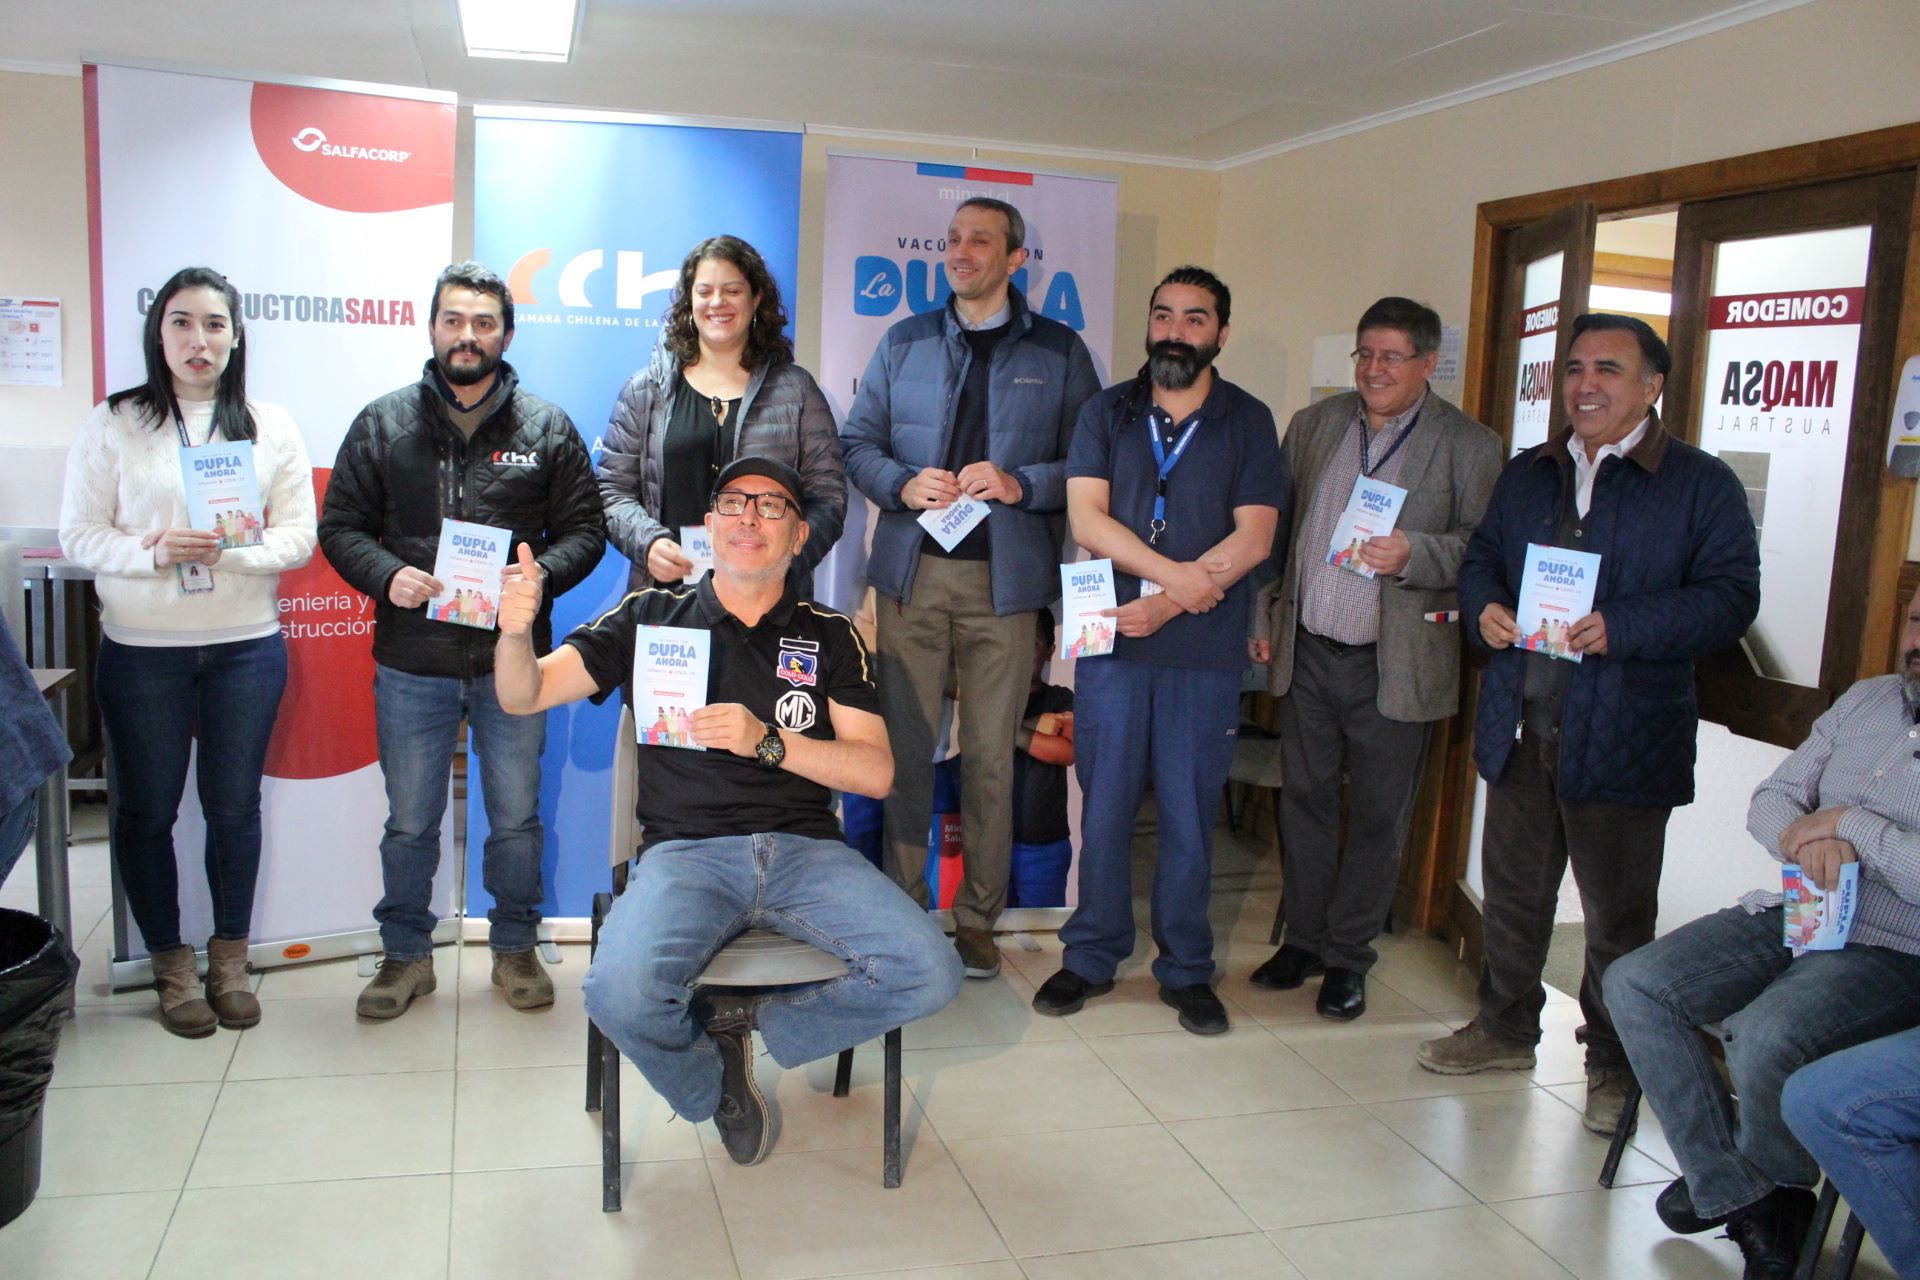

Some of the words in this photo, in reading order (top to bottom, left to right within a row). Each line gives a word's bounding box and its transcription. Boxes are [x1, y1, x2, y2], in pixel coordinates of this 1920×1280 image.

[321, 144, 409, 163] SALFACORP
[897, 237, 946, 252] VACÚ
[566, 315, 620, 327] CHILENA
[624, 318, 640, 327] DE
[645, 319, 659, 328] LA
[194, 455, 242, 472] DUPLA
[203, 469, 236, 478] AHORA
[1360, 489, 1392, 508] DUPLA
[941, 503, 974, 535] DUPLA
[452, 534, 496, 552] DUPLA
[457, 547, 488, 559] AHORA
[1537, 561, 1584, 579] DUPLA
[1071, 573, 1105, 586] DUPLA
[1543, 574, 1576, 587] AHORA
[278, 591, 351, 612] eniería
[356, 595, 370, 614] y
[648, 642, 696, 659] DUPLA
[655, 657, 688, 667] AHORA
[779, 694, 815, 730] MG
